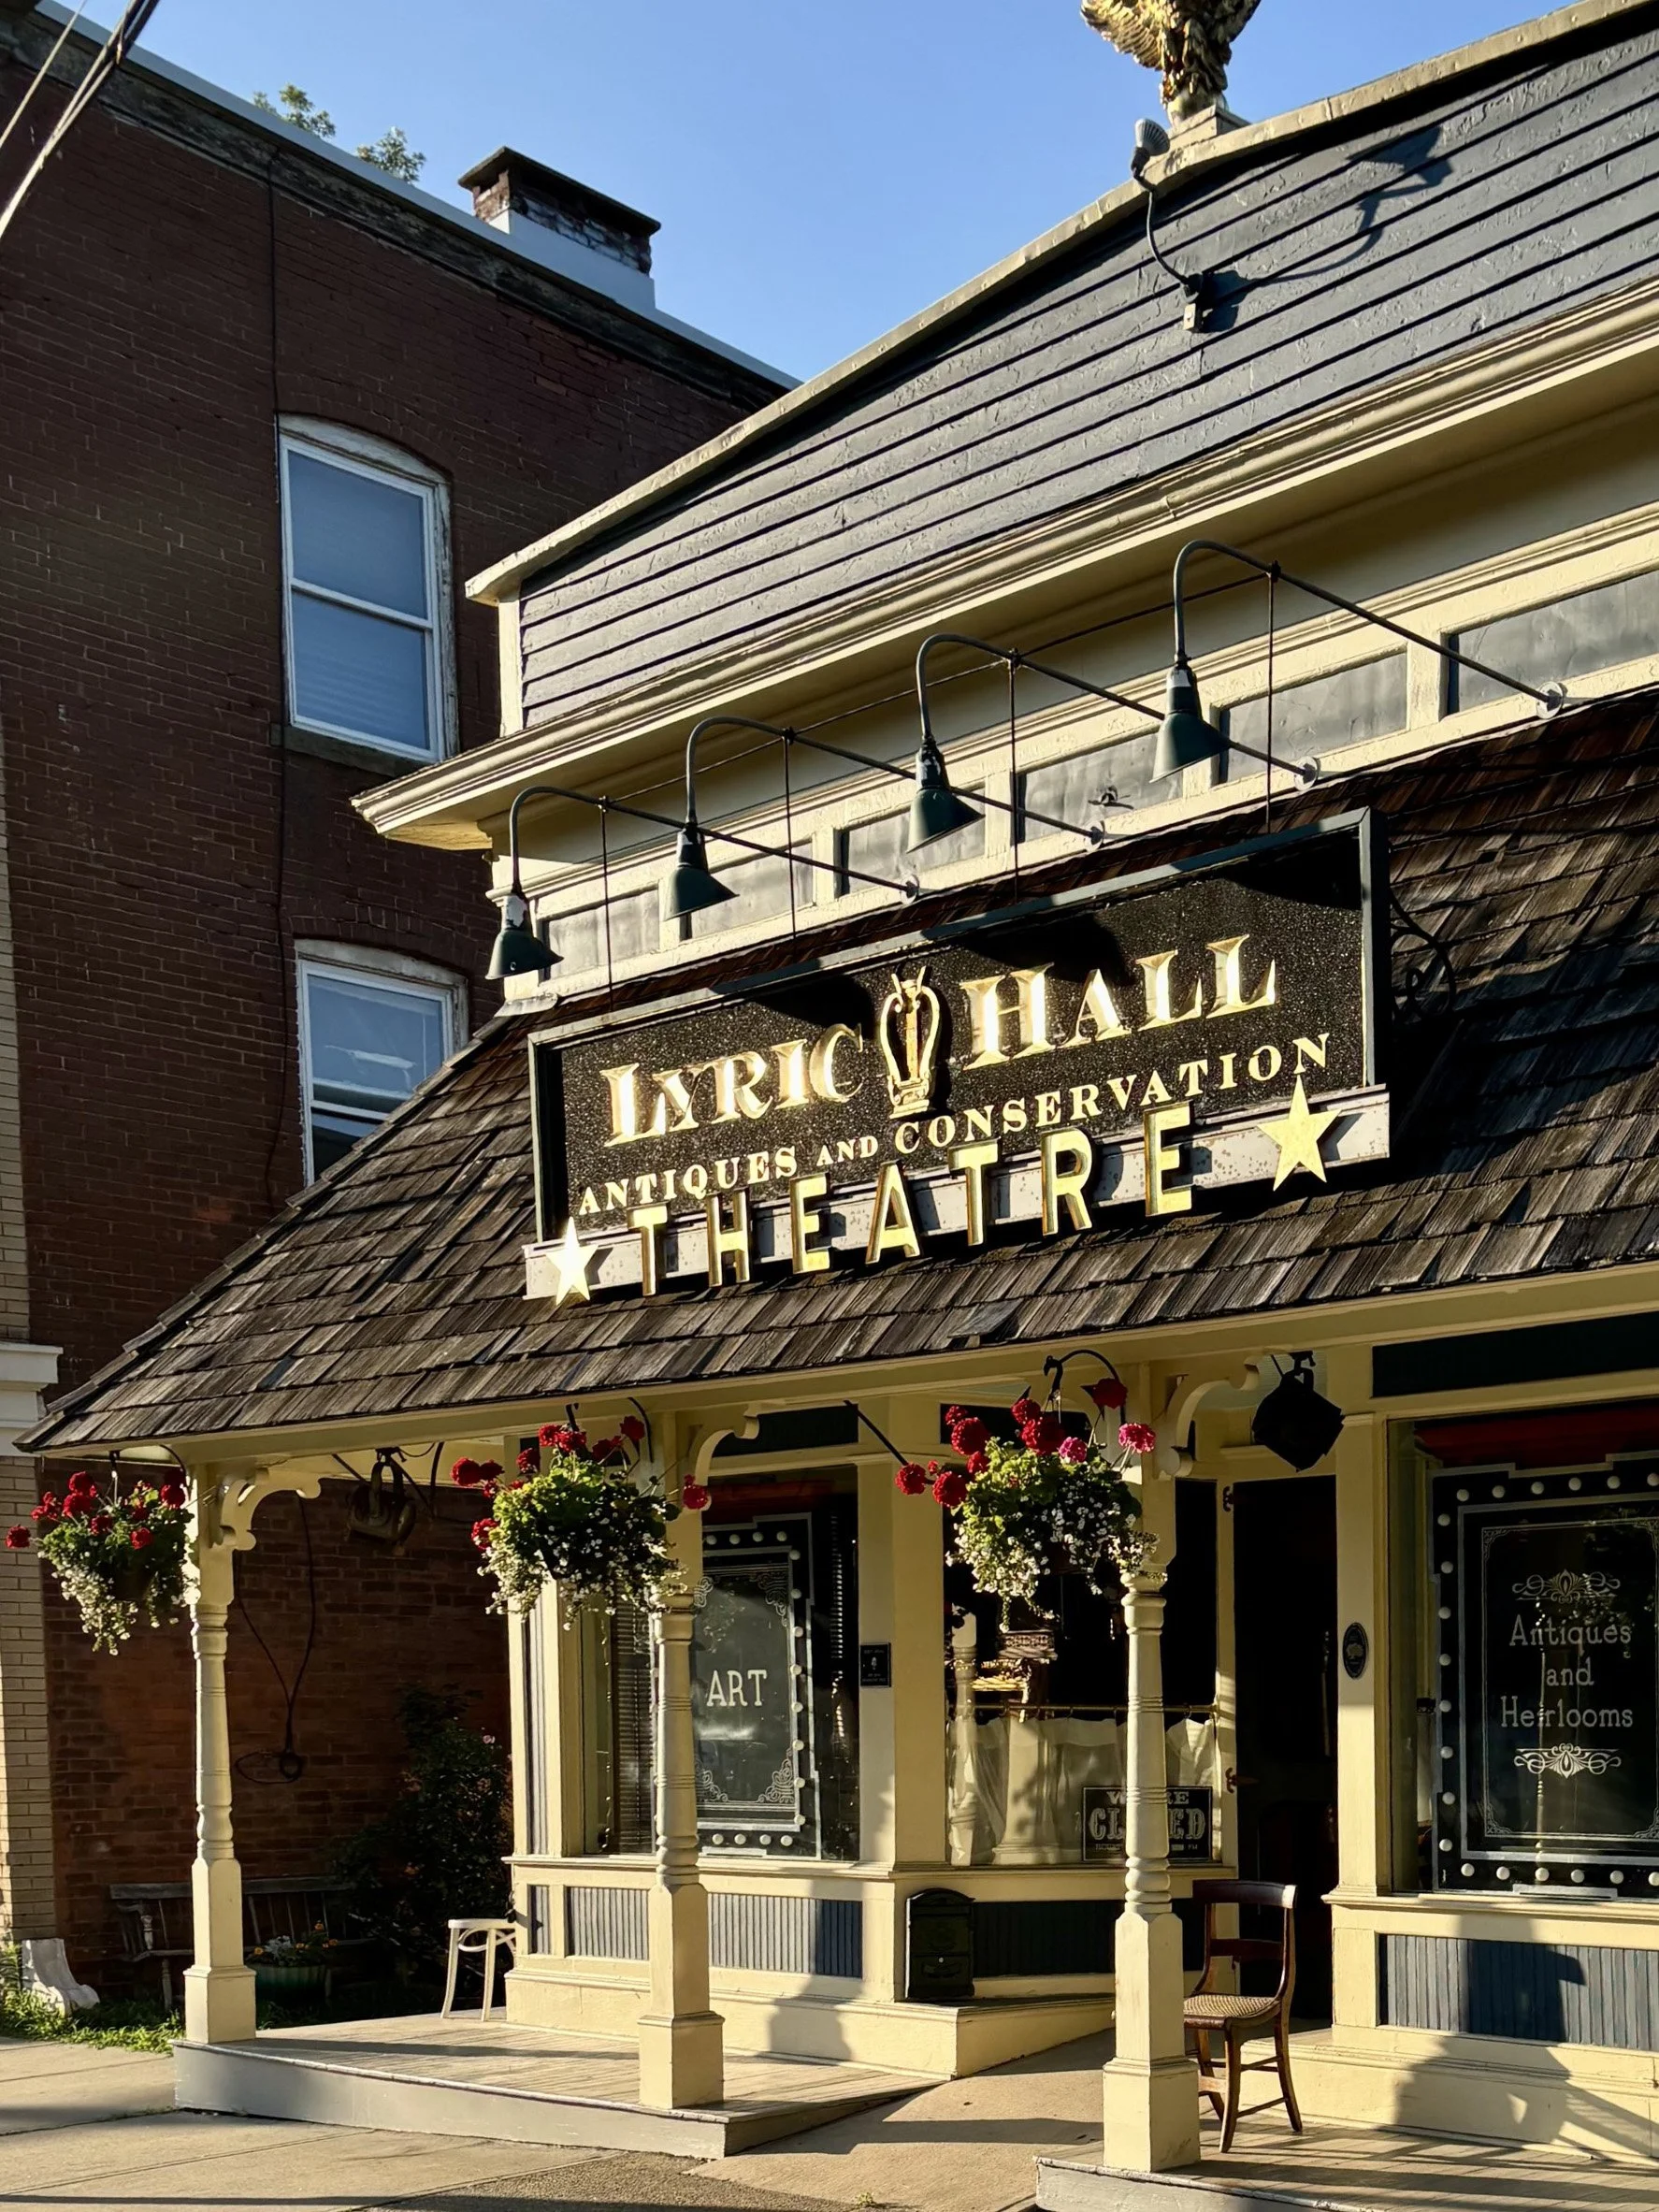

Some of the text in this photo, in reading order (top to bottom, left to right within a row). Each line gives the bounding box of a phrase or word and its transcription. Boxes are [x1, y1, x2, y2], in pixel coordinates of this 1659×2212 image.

[599, 934, 1276, 1148] LYRIC HALL
[579, 1034, 1330, 1215] ANTIQUES AND CONSERVATION
[628, 1101, 1194, 1296] THEATRE
[1509, 1613, 1632, 1656] Antiques
[706, 1669, 768, 1707] ART
[1546, 1656, 1594, 1686] and
[1501, 1695, 1633, 1728] Heirlooms
[1089, 1807, 1206, 1841] CLED
